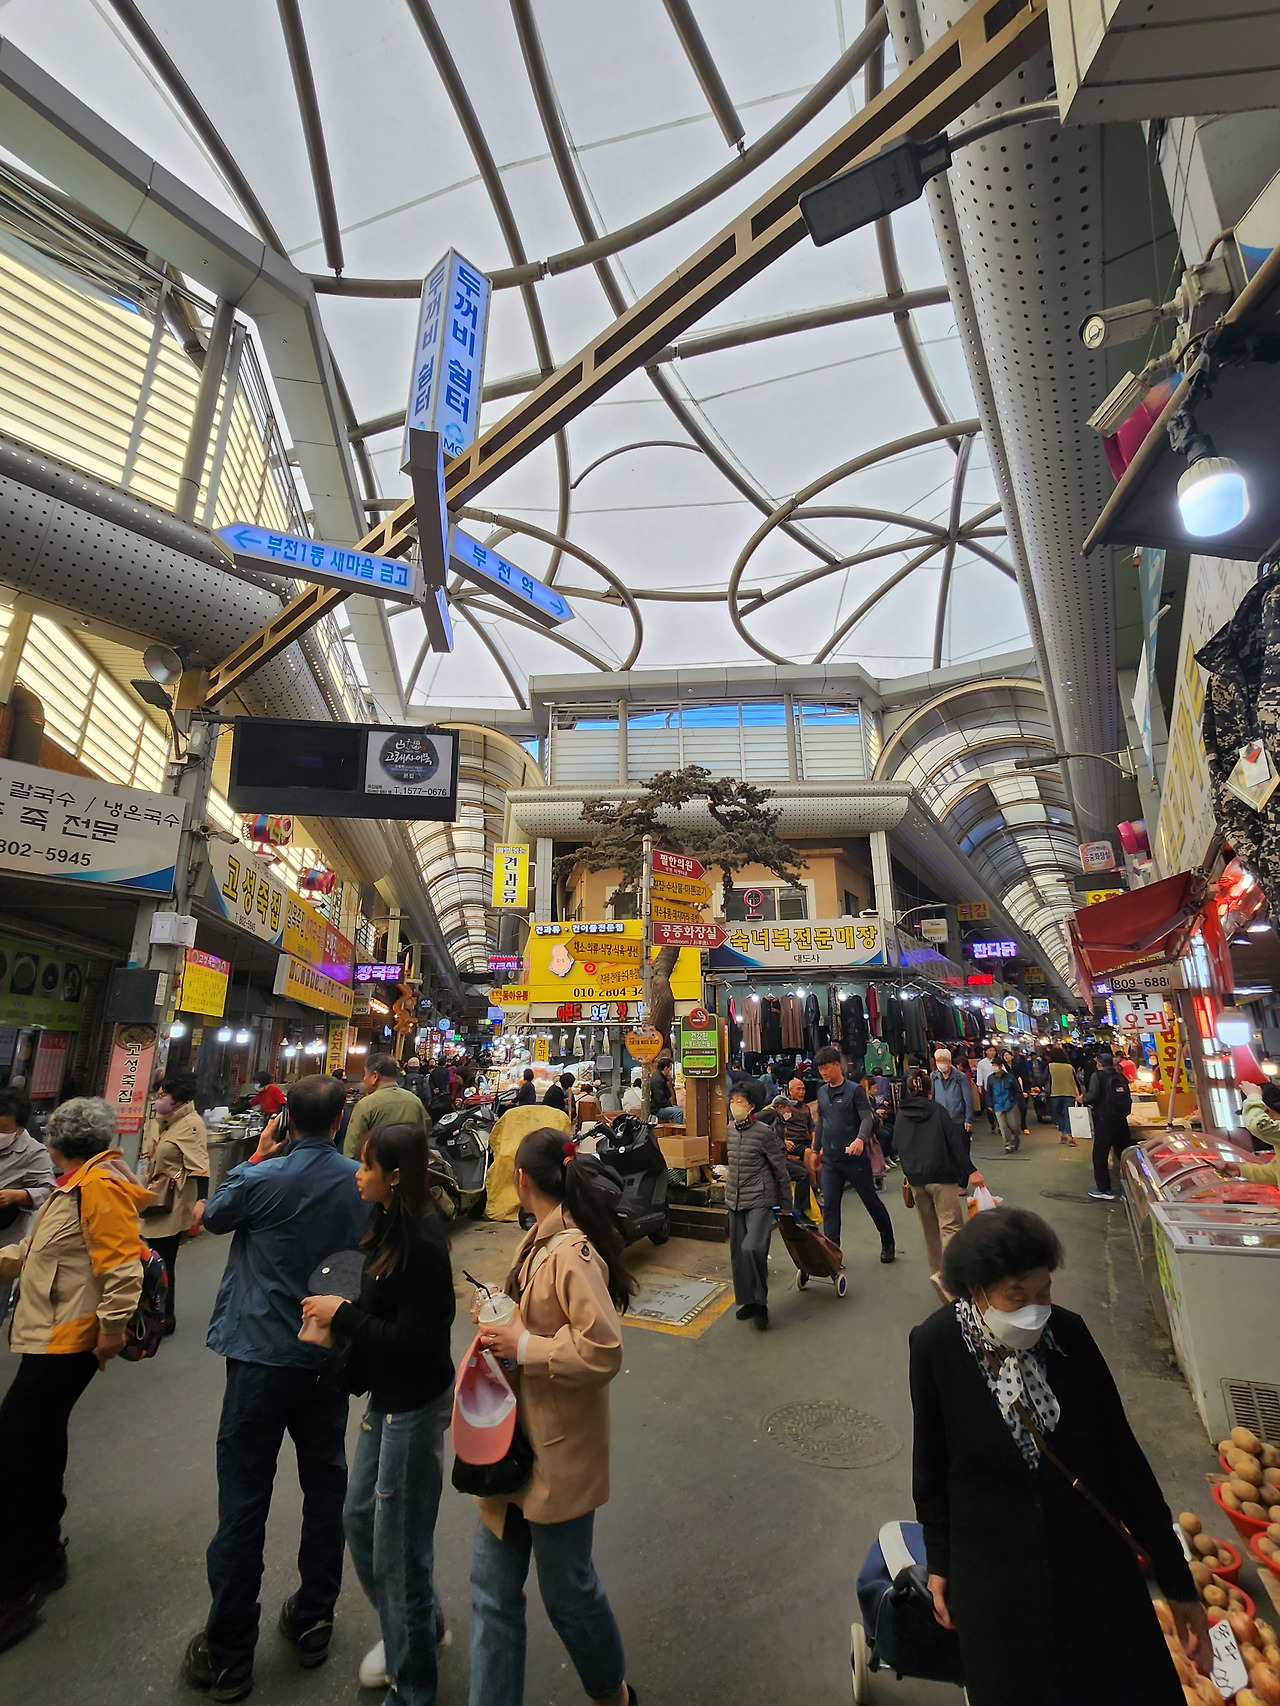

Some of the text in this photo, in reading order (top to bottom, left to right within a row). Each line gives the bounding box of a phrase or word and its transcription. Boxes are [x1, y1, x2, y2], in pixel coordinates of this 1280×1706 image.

[414, 266, 445, 417] 두꺼비 쉼터
[445, 265, 481, 425] 두꺼비 쉼터
[267, 535, 408, 587] 부전1동 새마을 금고
[10, 780, 76, 807] 칼국수
[104, 800, 180, 828] 냉온국수
[20, 806, 49, 832] 죽
[62, 814, 119, 843] 전문
[660, 853, 693, 872] 필한의원
[222, 854, 282, 933] 고성죽집
[959, 905, 987, 918] 튀김
[660, 924, 717, 940] 공중화장실
[730, 926, 878, 952] 숙녀복전문매장
[793, 953, 820, 963] 대도사
[973, 941, 1017, 958] 판다닭
[1123, 1011, 1167, 1030] 오리
[118, 1043, 142, 1104] 고성죽집
